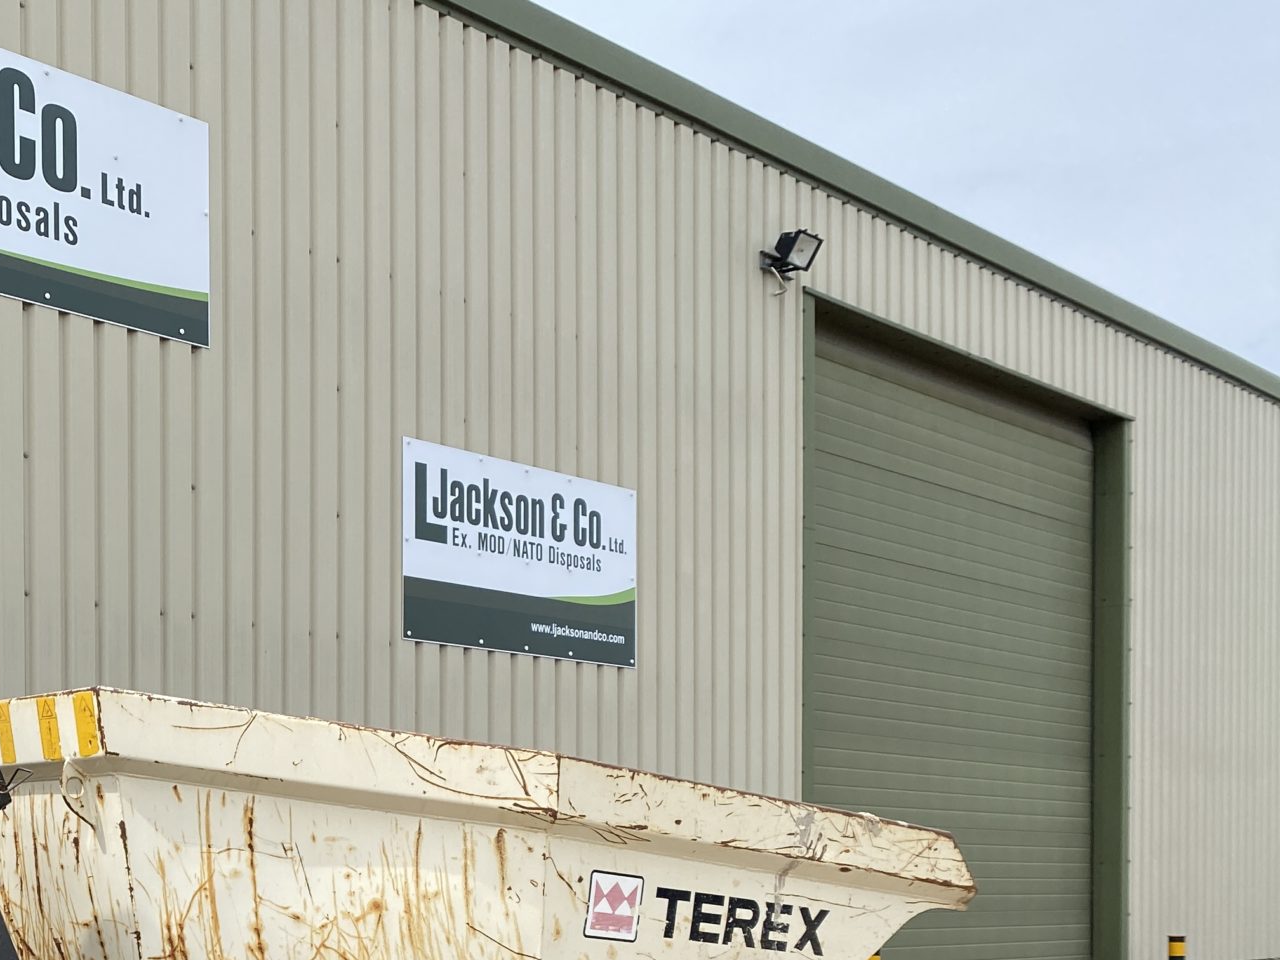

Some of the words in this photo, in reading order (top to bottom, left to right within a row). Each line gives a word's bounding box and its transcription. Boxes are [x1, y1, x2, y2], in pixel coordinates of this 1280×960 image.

[101, 172, 150, 218] Ltd.
[551, 493, 567, 542] &
[573, 497, 606, 551] Co.
[609, 537, 627, 555] Ltd.
[452, 527, 472, 549] Ex.
[477, 532, 543, 562] MOD/NATO
[548, 545, 602, 572] Disposals
[531, 622, 625, 645] www.ljacksonandco.com
[656, 886, 830, 957] TEREX
